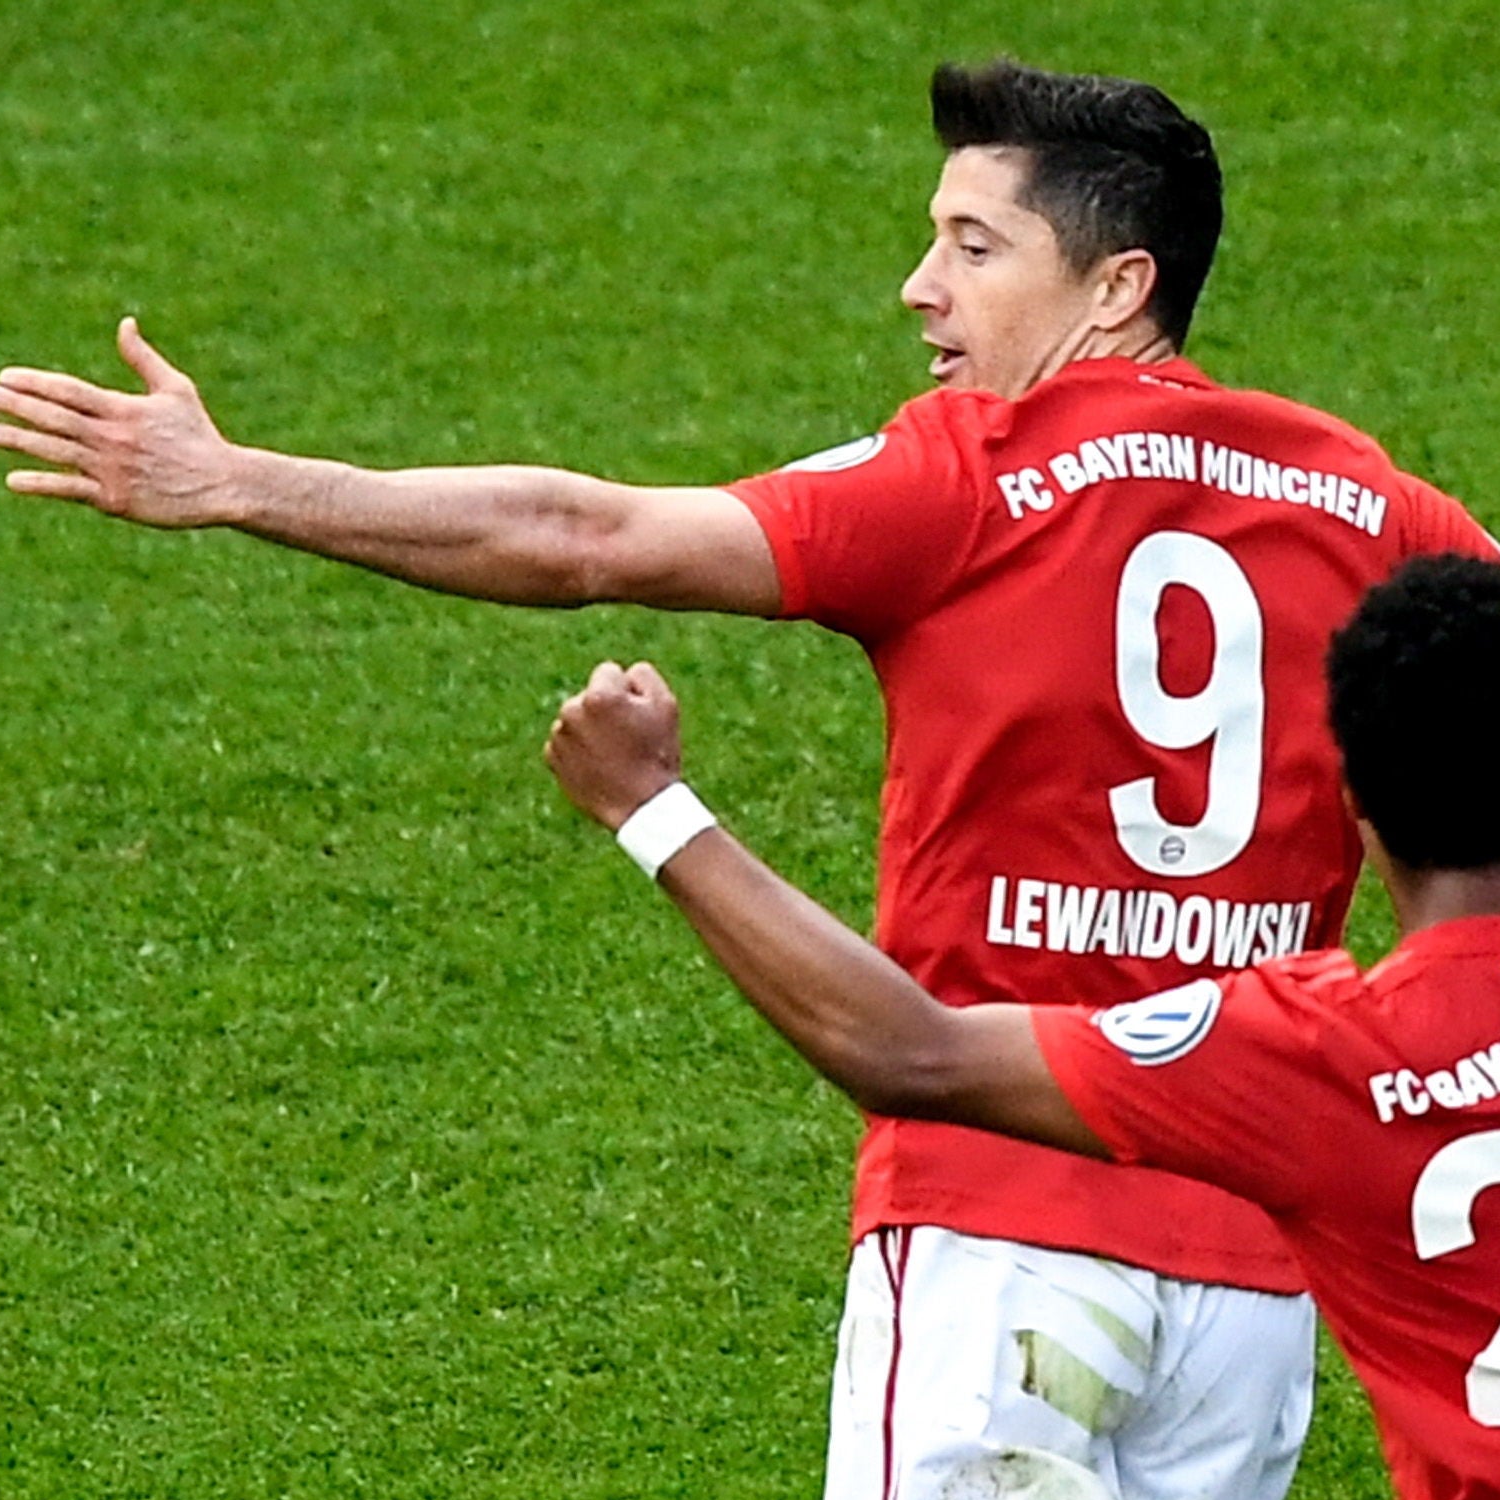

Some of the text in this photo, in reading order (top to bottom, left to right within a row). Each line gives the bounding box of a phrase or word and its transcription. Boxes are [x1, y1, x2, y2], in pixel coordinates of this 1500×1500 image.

[997, 467, 1054, 519] FC
[1048, 432, 1197, 494] BAYERN
[1109, 531, 1264, 877] 9
[986, 875, 1312, 968] LEWANDOWSKI
[1369, 1069, 1431, 1123] FC
